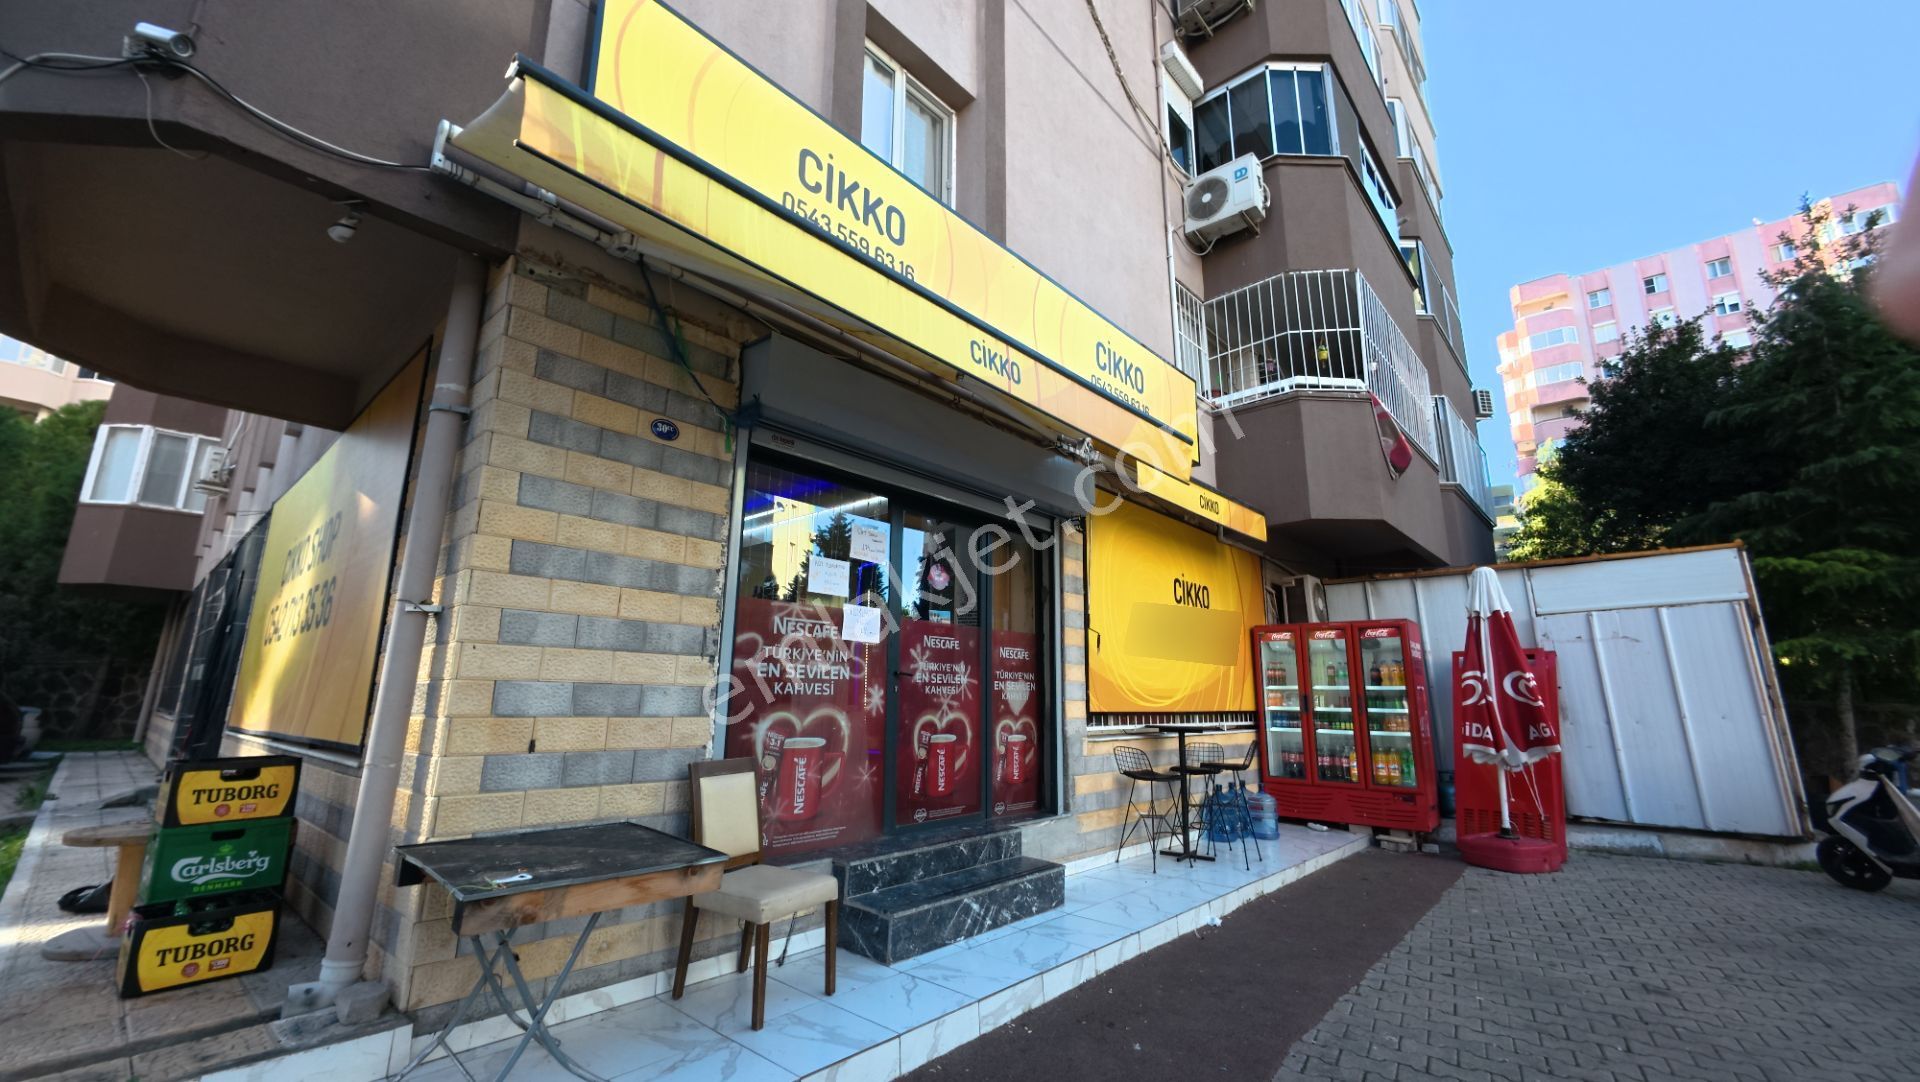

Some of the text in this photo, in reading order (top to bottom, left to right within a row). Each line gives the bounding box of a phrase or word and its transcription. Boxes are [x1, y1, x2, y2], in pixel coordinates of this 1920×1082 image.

[798, 148, 906, 246] CİKKO
[970, 339, 1021, 385] CİKKO
[1095, 341, 1144, 394] CİKKO
[1199, 492, 1219, 515] CİKKO
[1173, 573, 1210, 610] CİKKO
[756, 662, 851, 681] EN SEVİLEN
[916, 672, 930, 683] EN
[773, 680, 835, 696] KAHVESİ
[993, 681, 1006, 691] EN
[192, 783, 280, 806] TUBORG
[170, 850, 271, 886] Carlsberg
[192, 880, 244, 893] DENMARK
[156, 933, 256, 968] TUBORG
